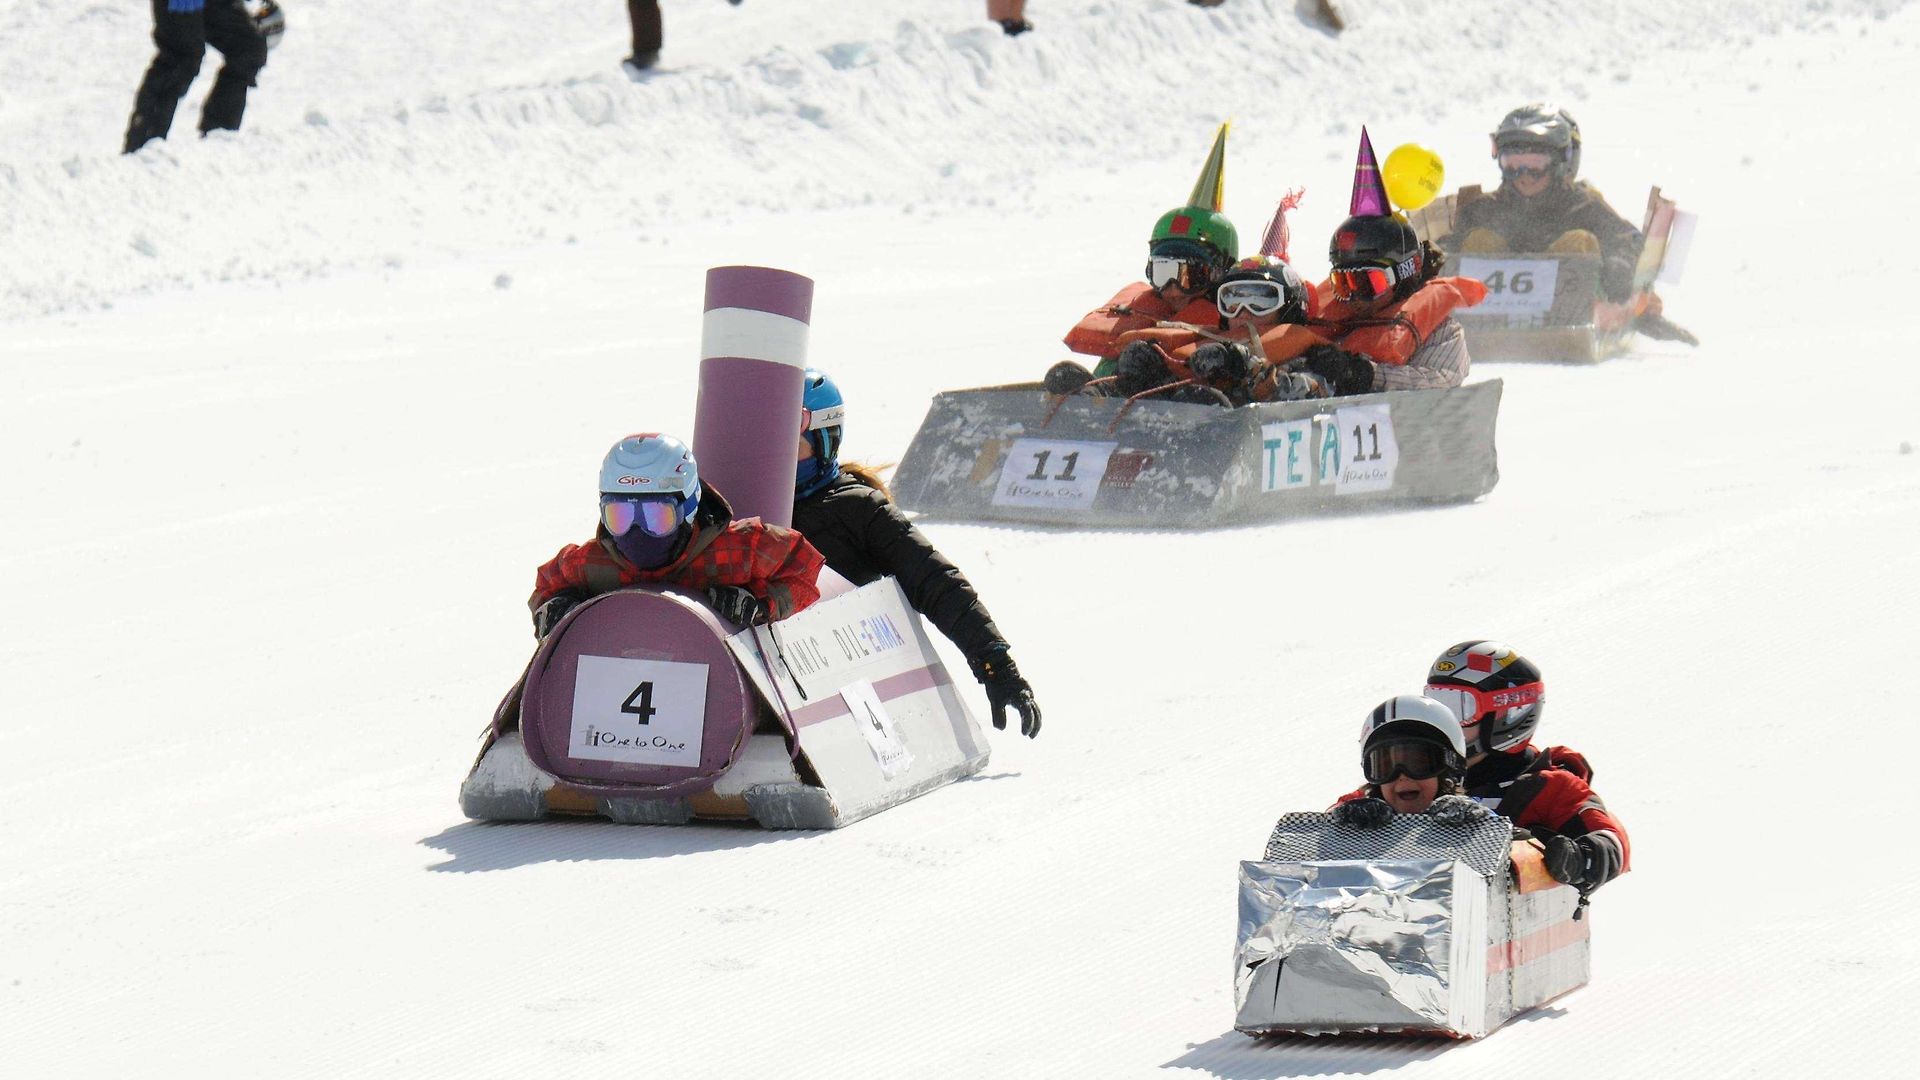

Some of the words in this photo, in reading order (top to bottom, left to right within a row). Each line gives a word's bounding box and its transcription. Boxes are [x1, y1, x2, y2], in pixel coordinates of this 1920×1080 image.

[1484, 270, 1535, 294] 46
[1353, 423, 1382, 462] 11
[618, 476, 651, 486] Giro
[1026, 450, 1080, 481] 11
[620, 681, 657, 725] 4
[864, 700, 888, 739] 4
[601, 731, 630, 746] One
[635, 736, 648, 748] to
[652, 735, 686, 751] One
